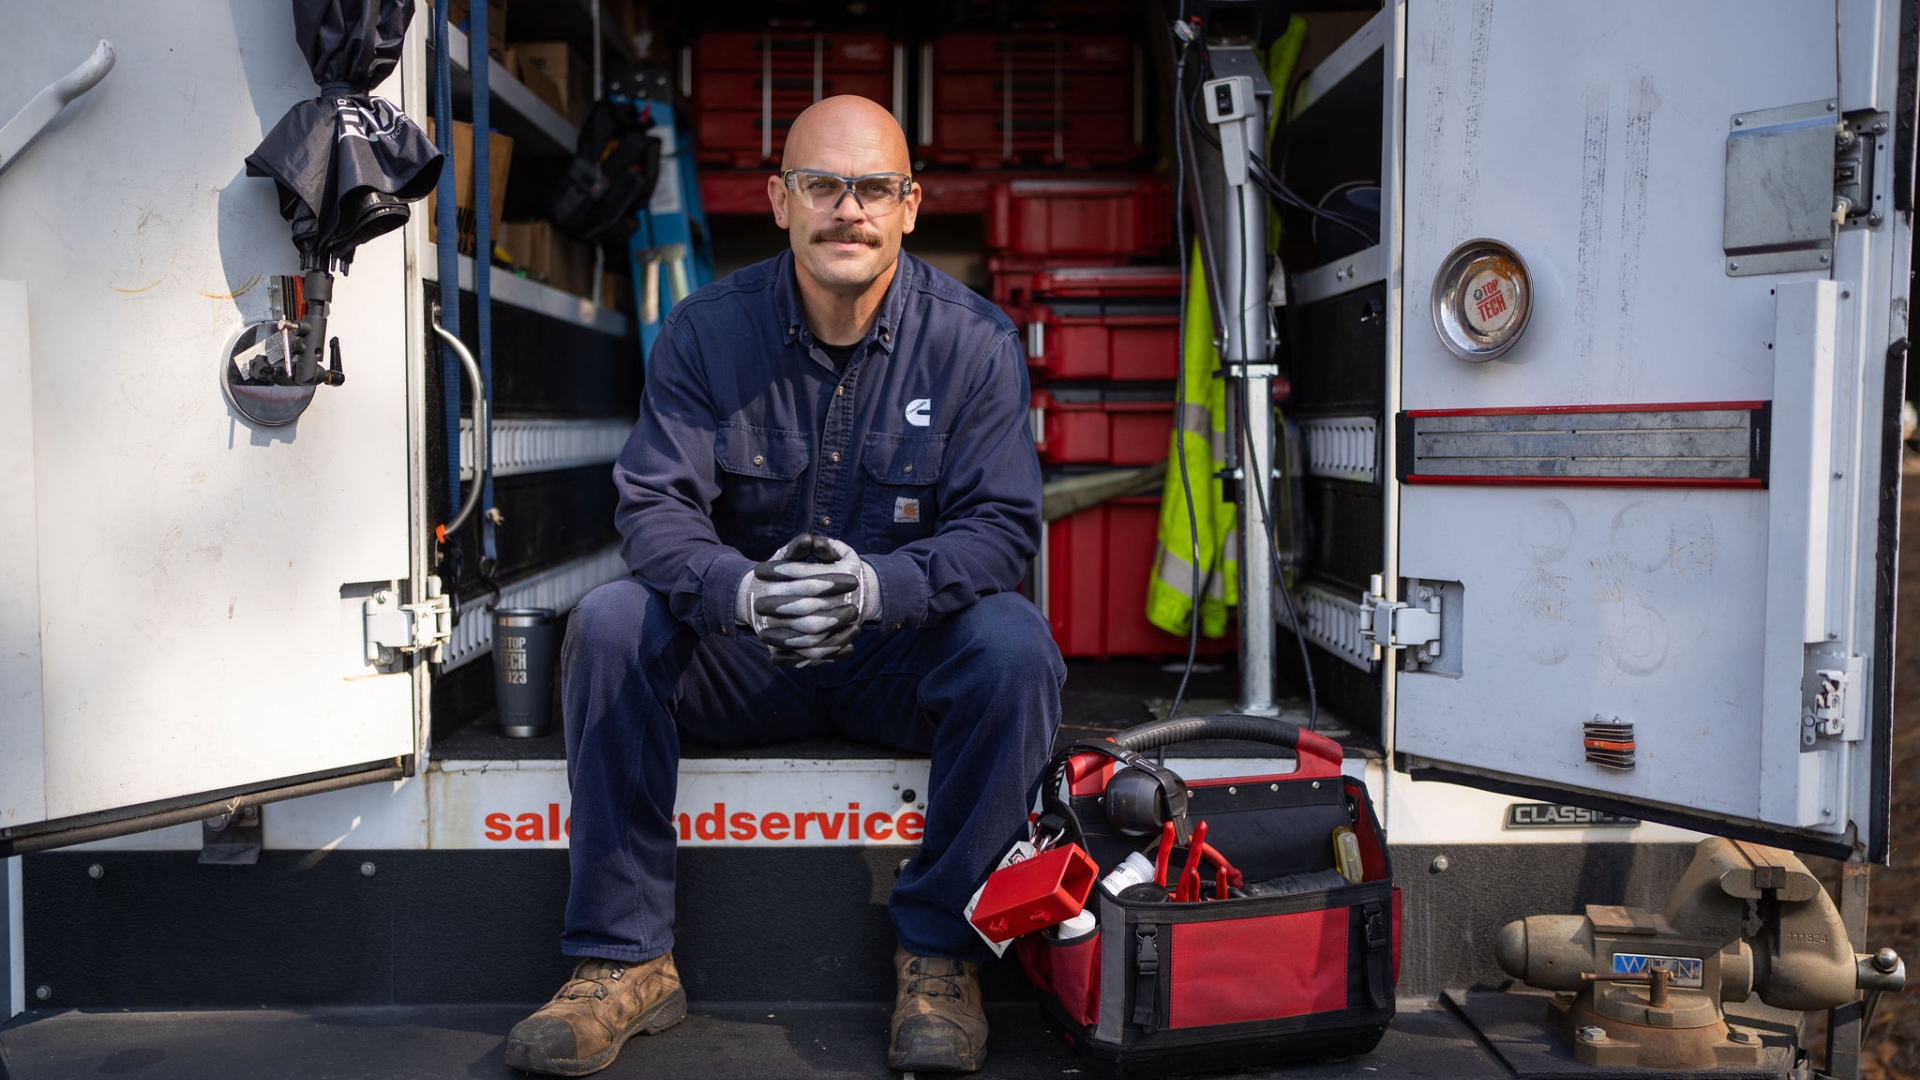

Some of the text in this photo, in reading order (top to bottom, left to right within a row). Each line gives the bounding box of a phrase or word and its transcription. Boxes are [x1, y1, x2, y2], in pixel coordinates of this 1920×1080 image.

[1481, 279, 1499, 296] TOP
[1476, 293, 1507, 322] TECH
[508, 636, 527, 649] TOP
